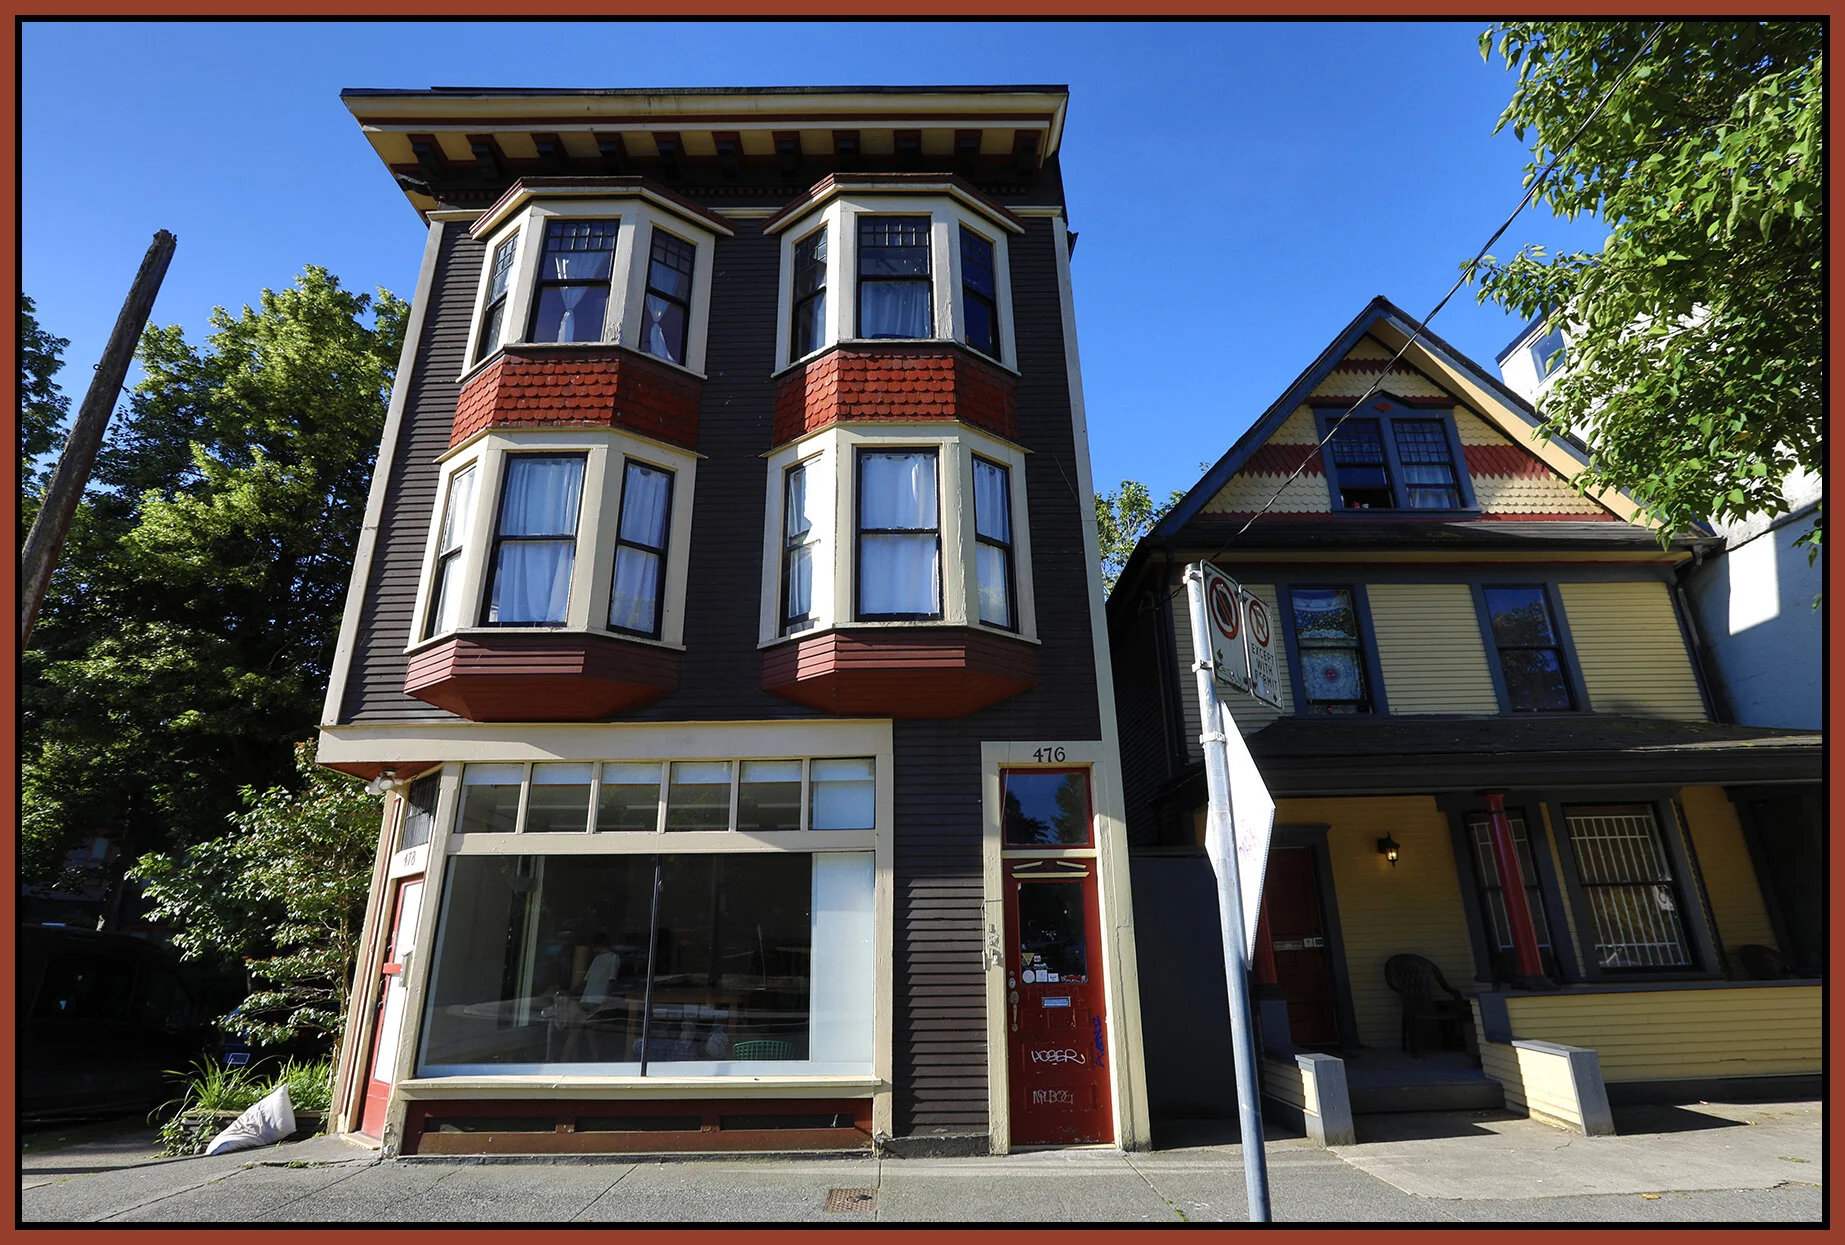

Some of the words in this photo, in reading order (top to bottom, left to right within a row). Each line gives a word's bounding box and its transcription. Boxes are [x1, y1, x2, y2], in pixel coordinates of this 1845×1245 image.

[1251, 643, 1274, 662] EXCEPT
[1257, 661, 1273, 675] WITH
[1255, 670, 1278, 690] PERMIT
[1033, 746, 1066, 763] 476
